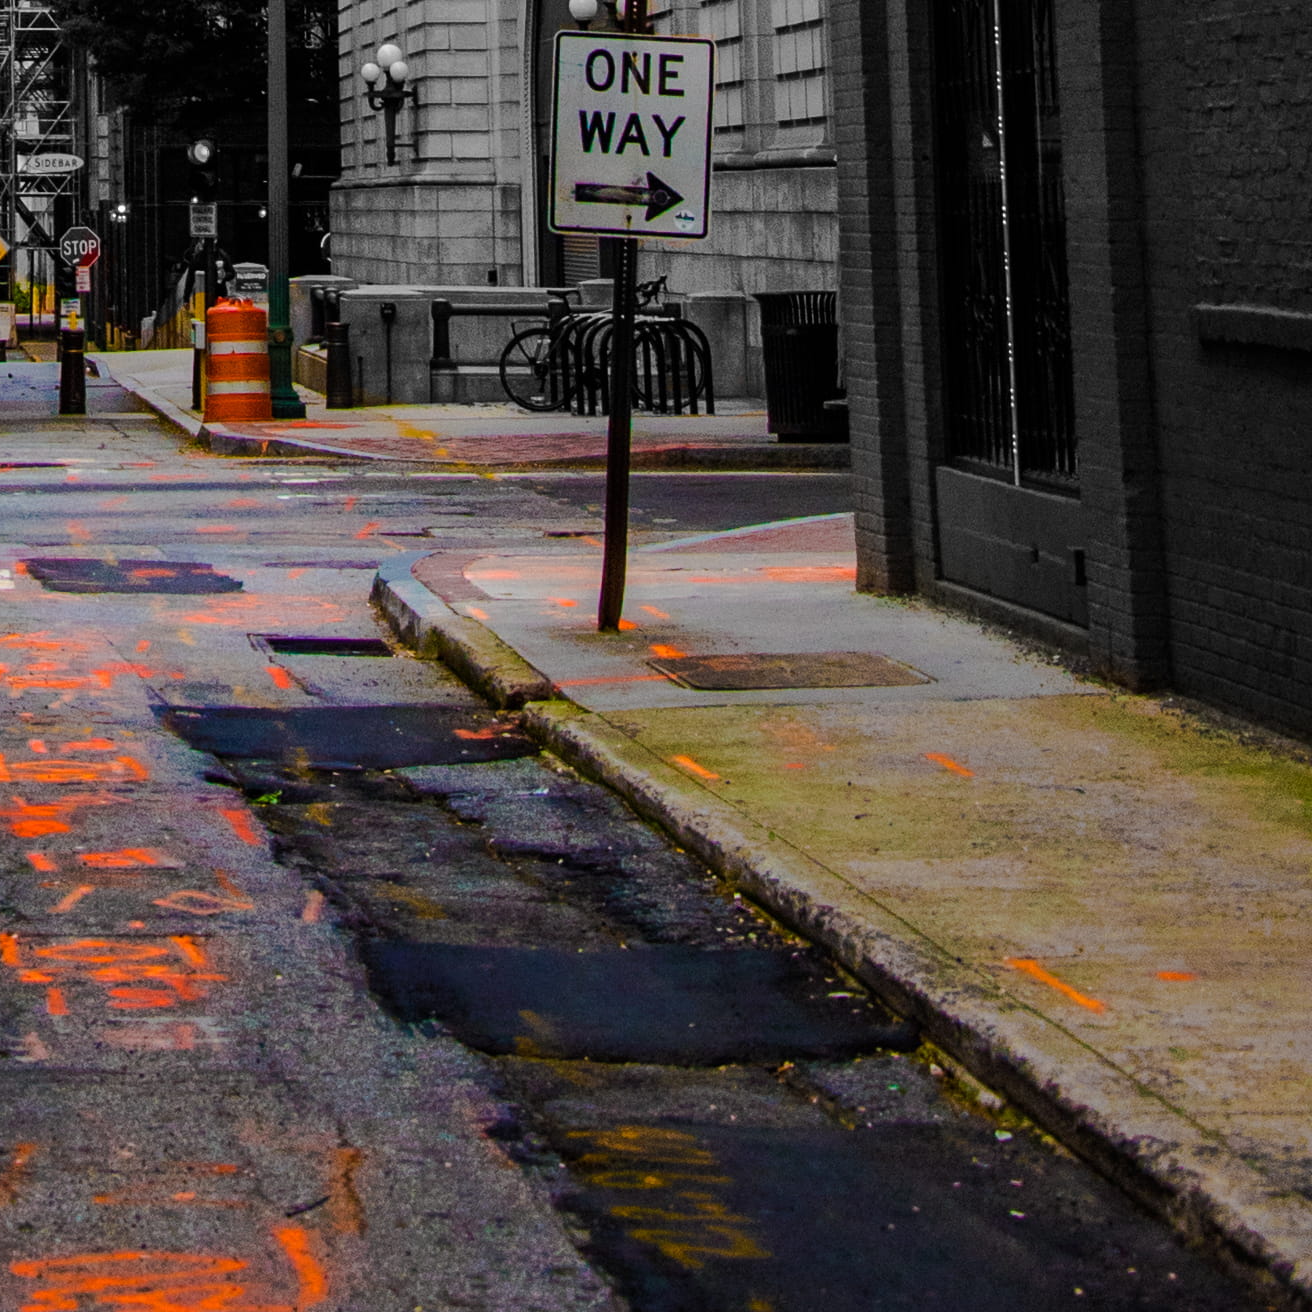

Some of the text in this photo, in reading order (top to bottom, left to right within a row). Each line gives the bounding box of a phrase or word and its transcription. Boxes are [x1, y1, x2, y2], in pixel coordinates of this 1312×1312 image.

[585, 48, 685, 97] ONE
[579, 110, 686, 158] WAY
[34, 157, 78, 168] SIDEBAR
[63, 239, 96, 255] STOP
